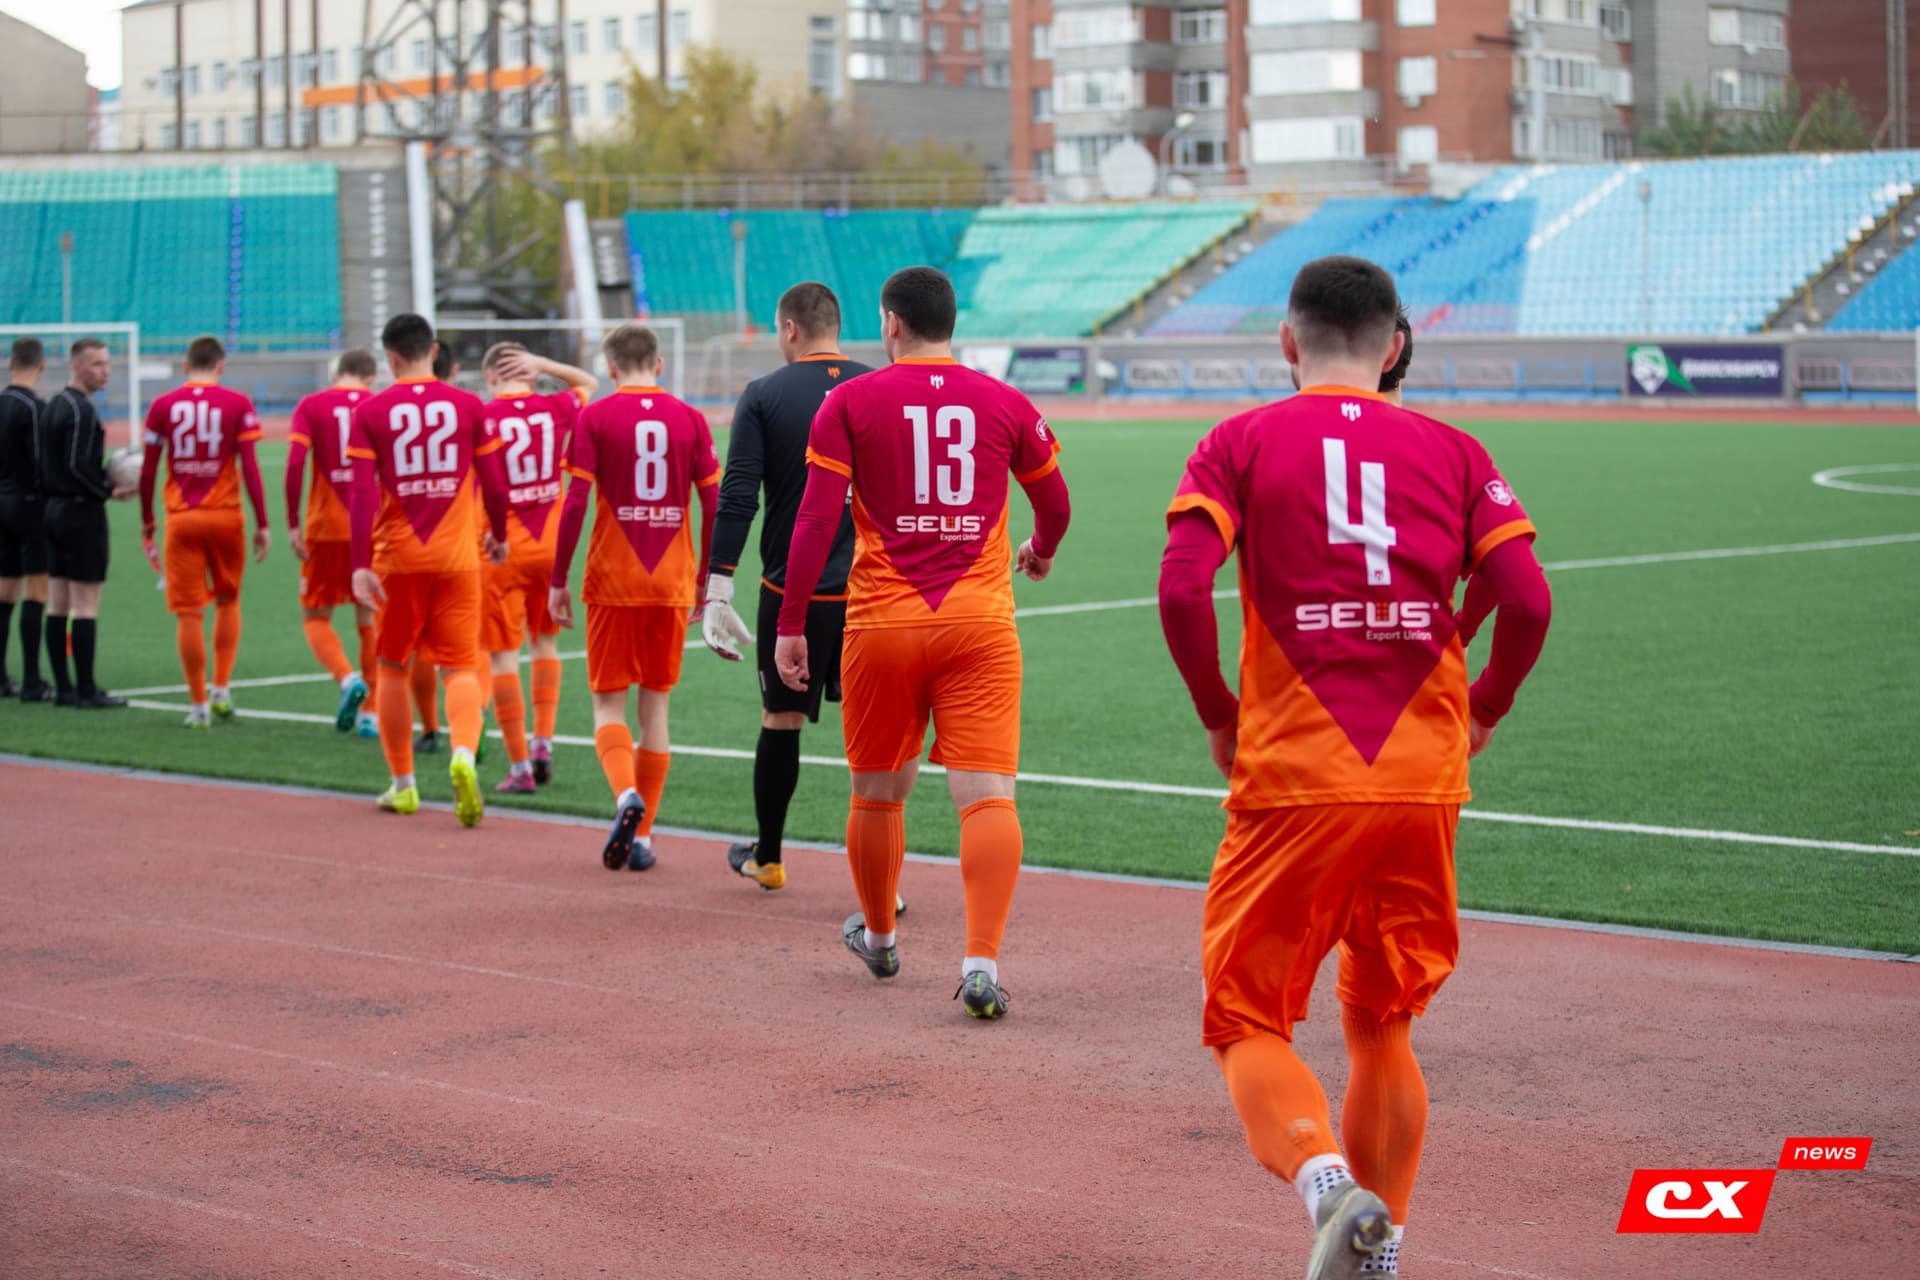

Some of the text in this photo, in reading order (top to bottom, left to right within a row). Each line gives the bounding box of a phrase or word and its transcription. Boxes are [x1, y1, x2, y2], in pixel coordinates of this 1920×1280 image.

[170, 401, 223, 458] 24
[389, 400, 459, 477] 22
[499, 412, 555, 485] 27
[635, 420, 668, 501] 8
[903, 405, 976, 506] 13
[396, 478, 459, 496] SEUS
[508, 482, 560, 503] SEUS
[616, 506, 682, 521] SEUS
[896, 515, 981, 533] SEUS
[1322, 437, 1396, 585] 4
[1295, 601, 1431, 631] SEUS
[1366, 630, 1432, 640] Export Union
